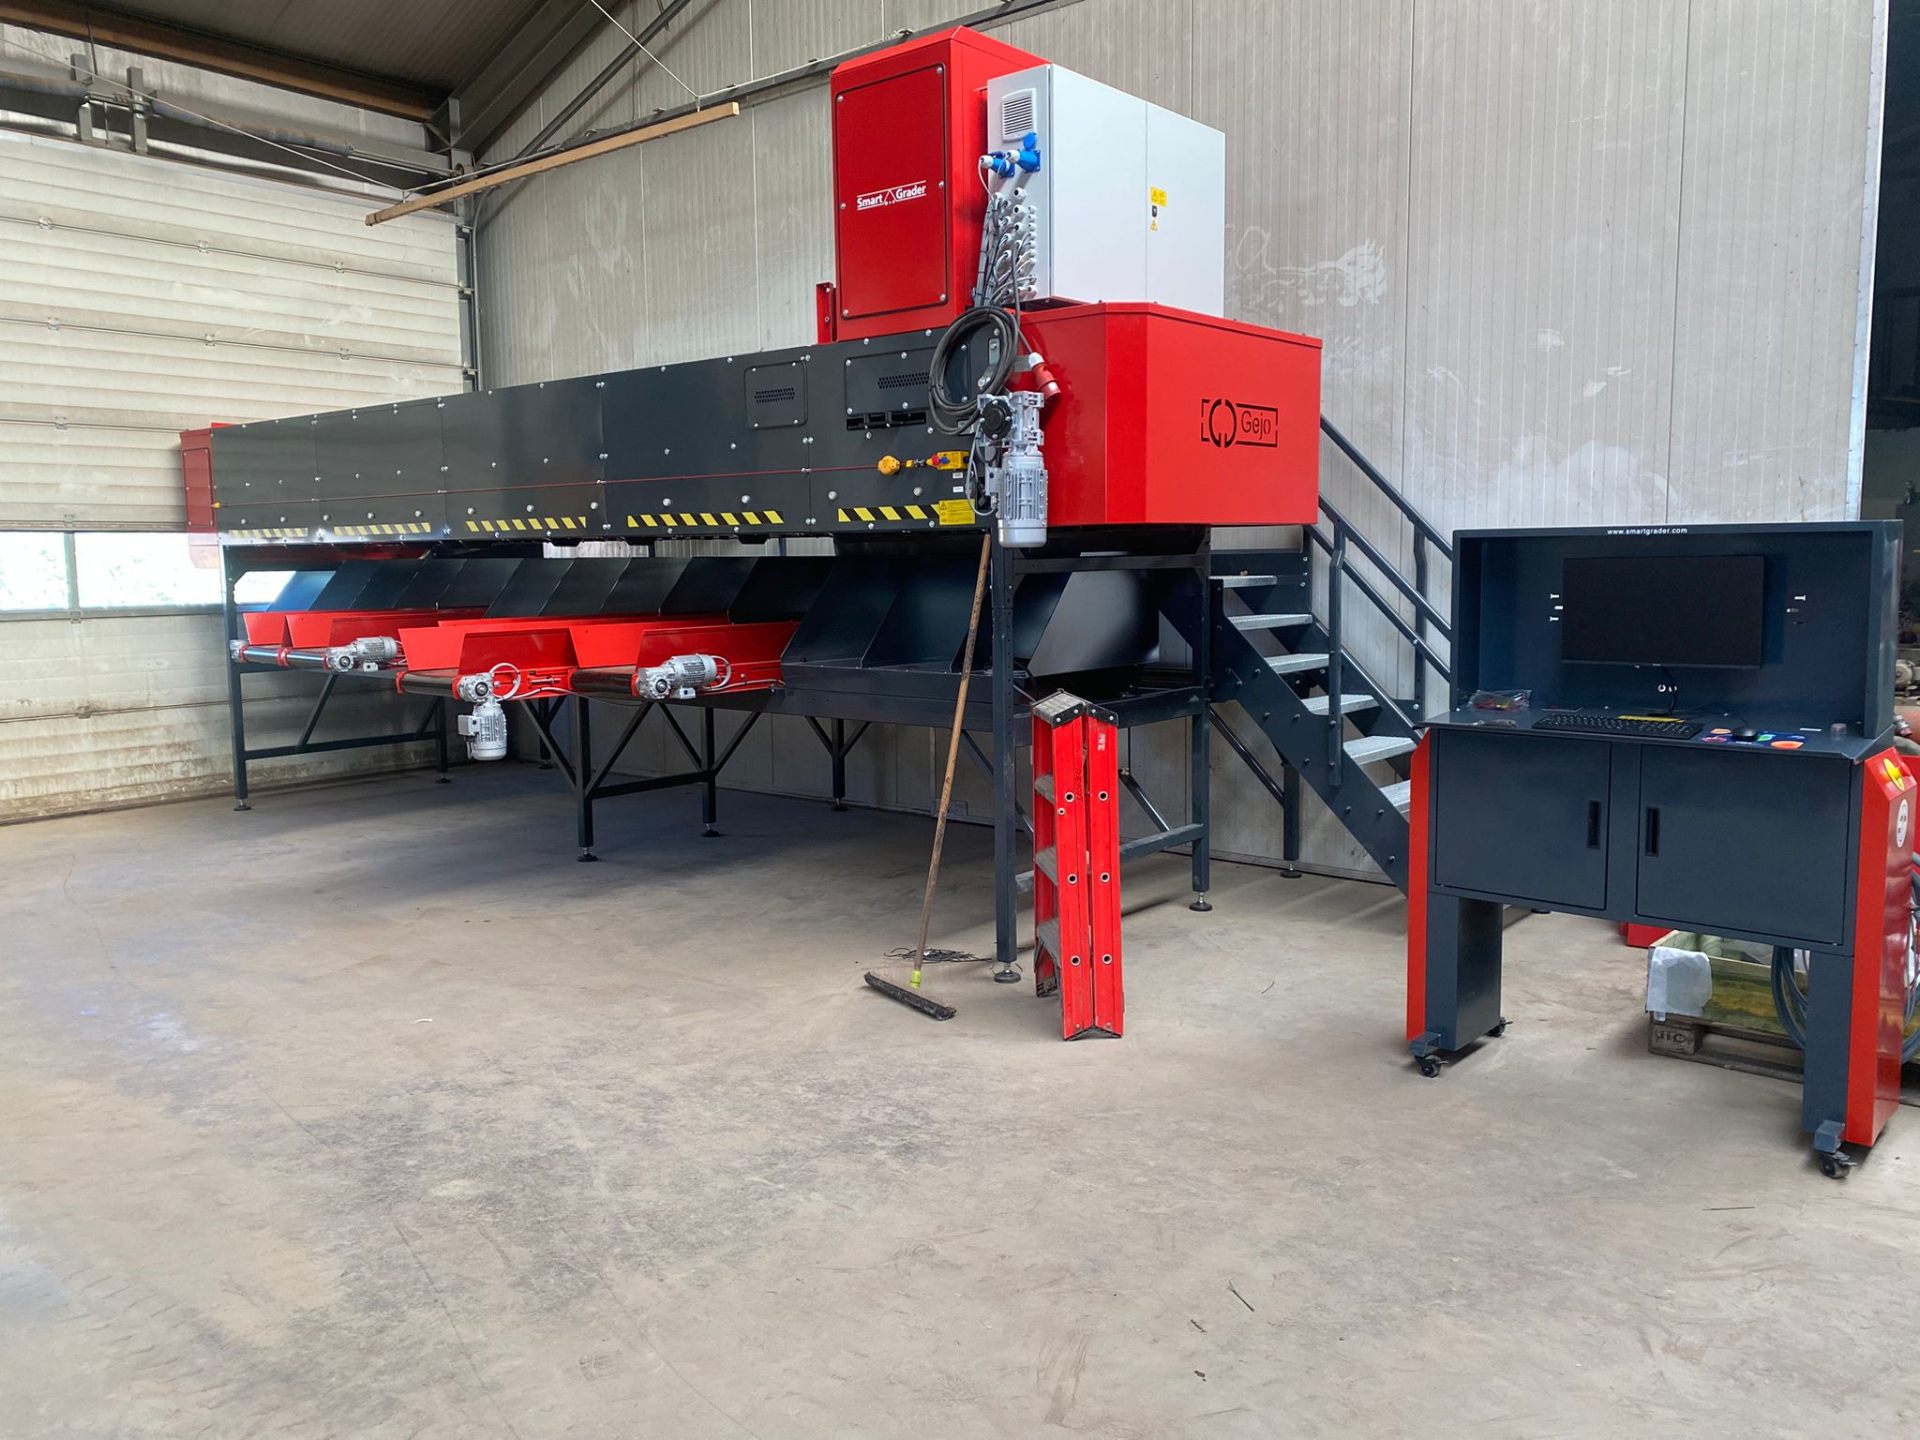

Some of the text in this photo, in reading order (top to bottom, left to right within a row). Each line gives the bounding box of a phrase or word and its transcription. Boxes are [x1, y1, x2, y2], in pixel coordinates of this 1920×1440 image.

[857, 185, 926, 208] Smart Grader
[1241, 410, 1271, 440] Gejo
[1607, 527, 1688, 536] www.smartgrader.com
